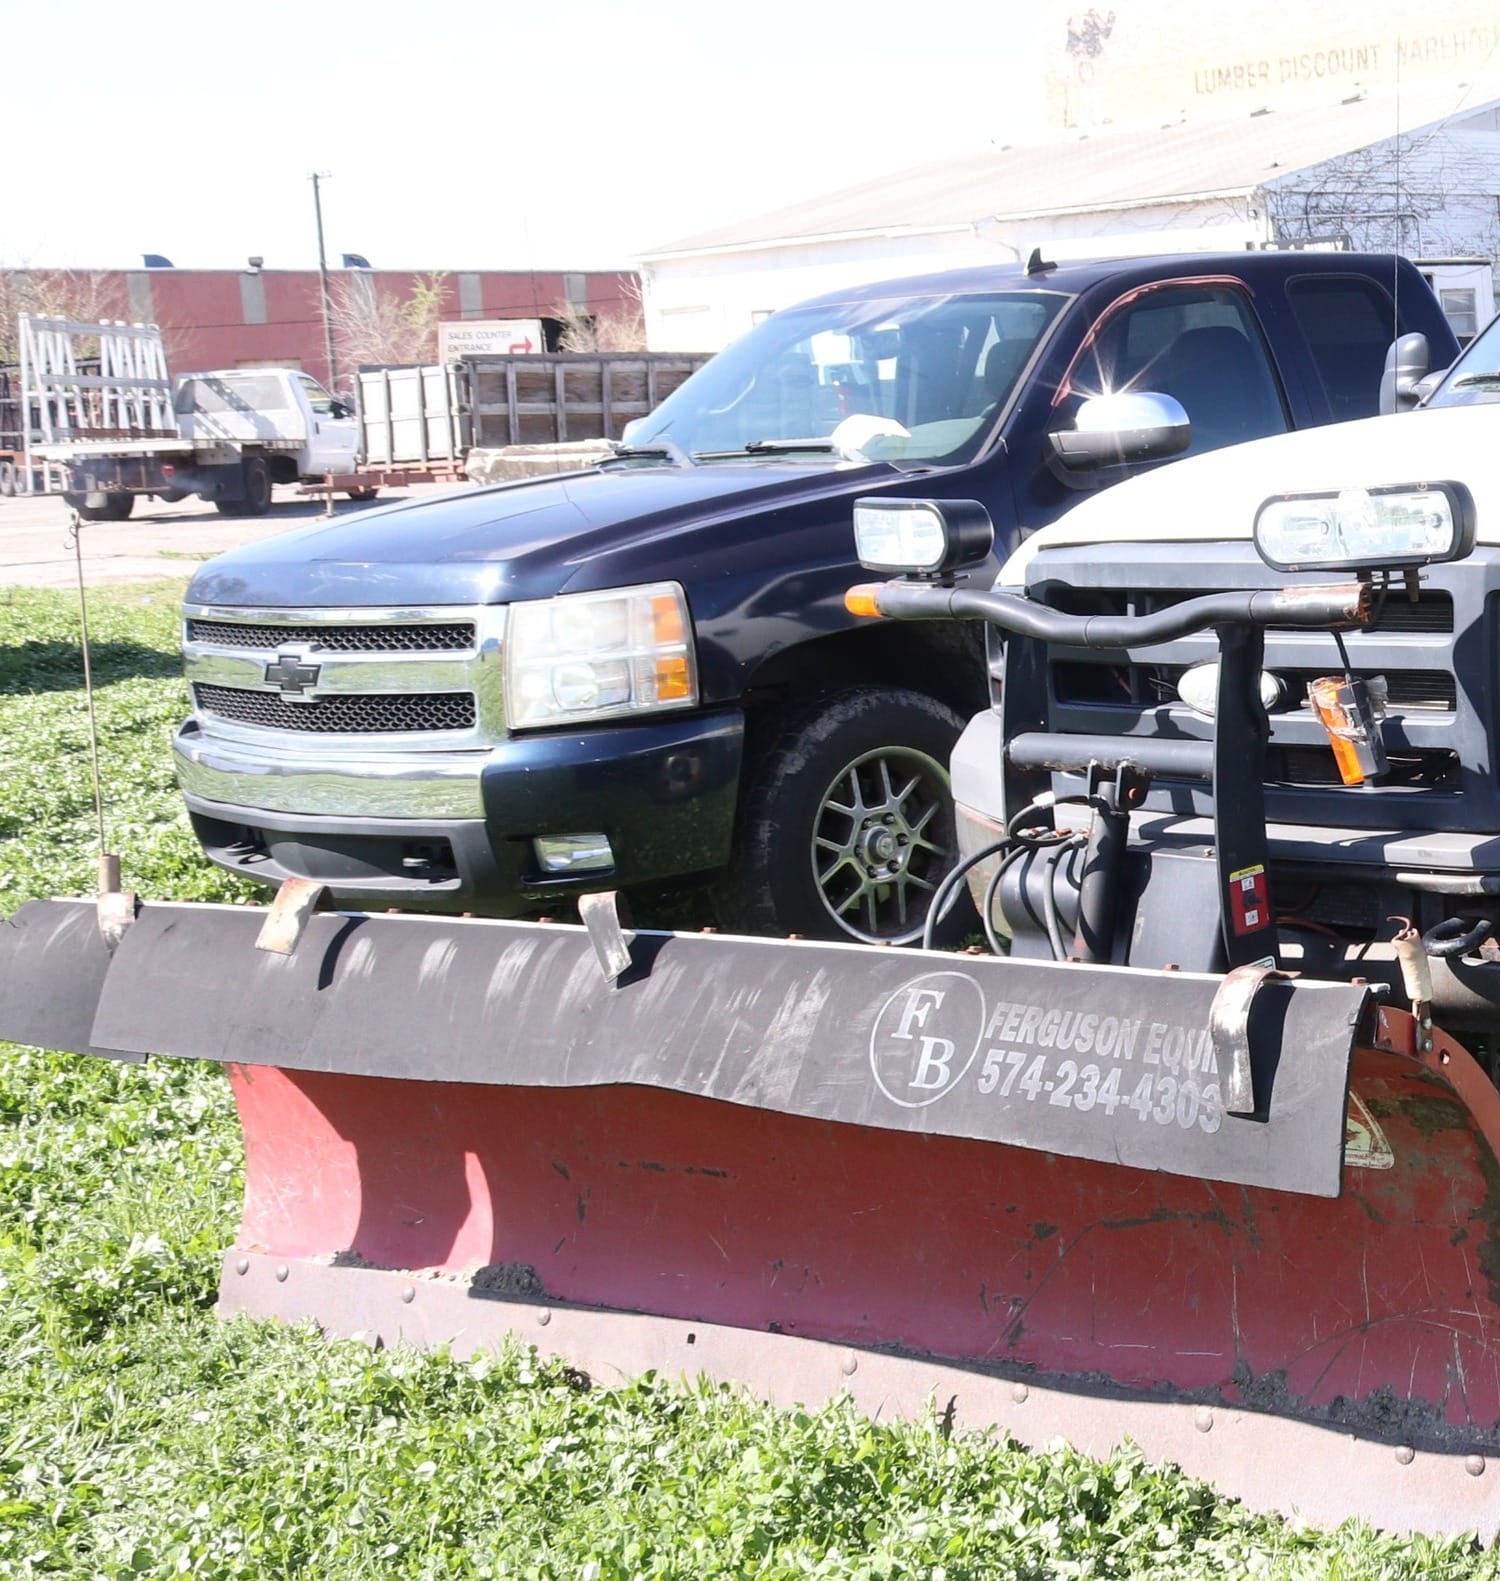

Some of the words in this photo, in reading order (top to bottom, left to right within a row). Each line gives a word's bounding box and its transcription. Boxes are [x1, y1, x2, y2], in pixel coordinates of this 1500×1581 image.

[1194, 60, 1270, 95] LUMBER
[1279, 44, 1379, 83] DISCOUNT
[447, 343, 494, 352] ENTRANCE
[448, 331, 473, 339] SALES
[475, 330, 513, 339] COUNTER
[984, 1002, 1142, 1060] FERGUSON
[977, 1048, 1223, 1134] 574-234-4303
